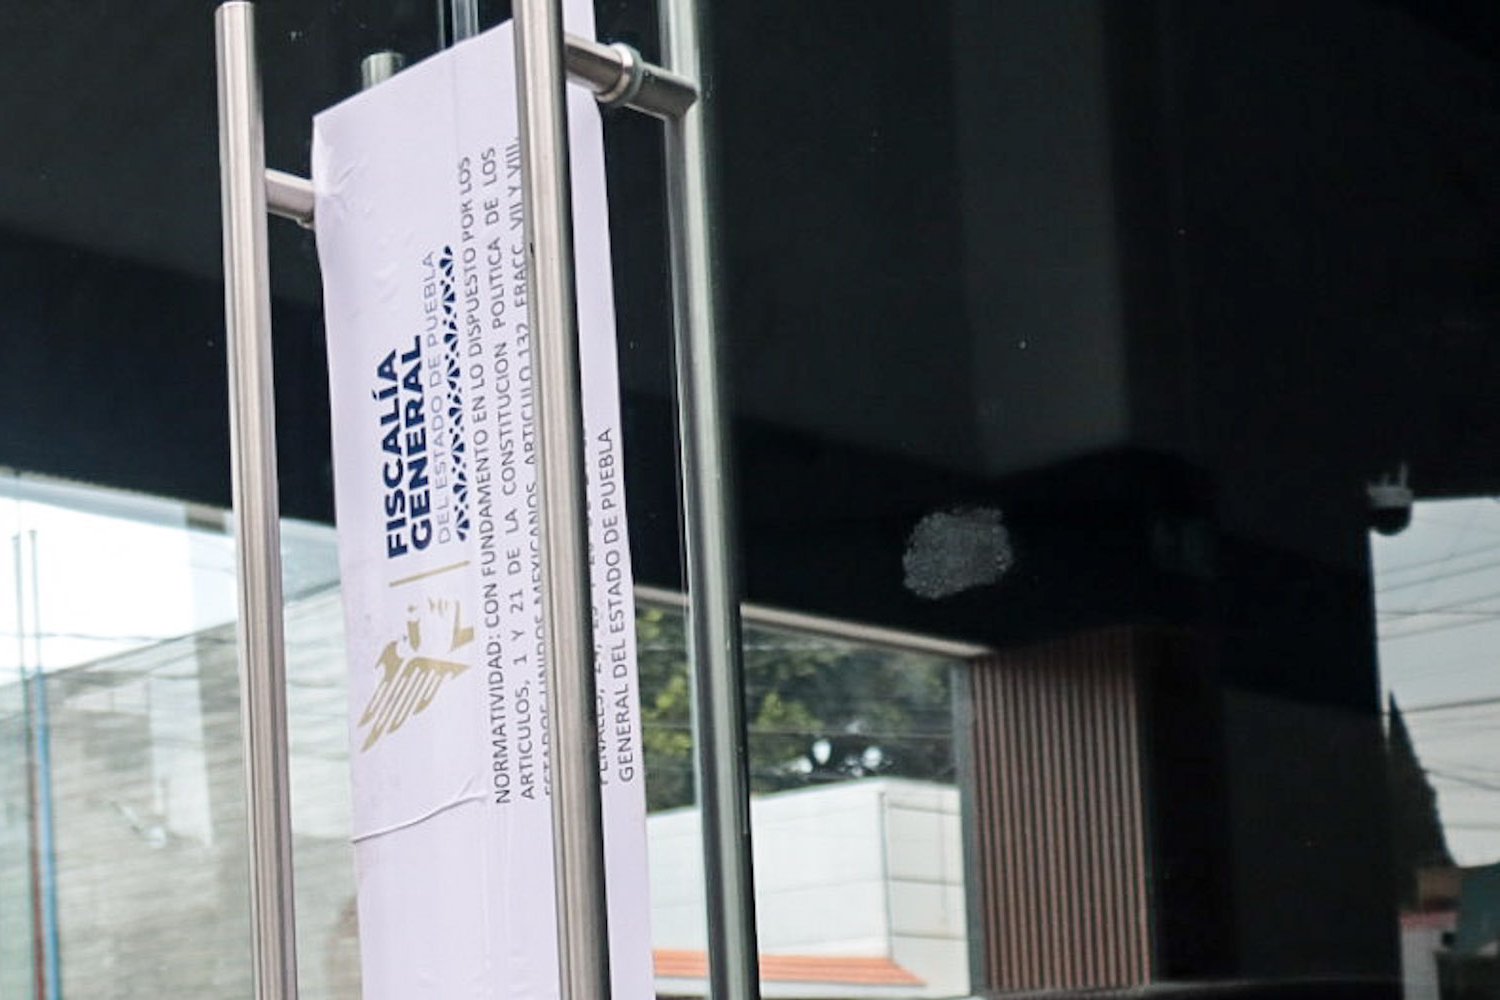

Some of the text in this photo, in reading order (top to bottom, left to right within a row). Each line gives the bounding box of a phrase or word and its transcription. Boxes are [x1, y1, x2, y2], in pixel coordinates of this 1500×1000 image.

[457, 156, 472, 194] LOS
[506, 184, 522, 196] Y
[462, 247, 482, 357] DISPUESTO
[402, 335, 432, 550] GENERAL
[422, 250, 452, 544] DEL ESTADO DE PUEBLA
[468, 364, 484, 390] LO
[470, 396, 487, 424] EN
[371, 349, 408, 559] FISCALÍA
[472, 429, 496, 577] FUNDAMENTO
[480, 147, 536, 800] ARTICULOS, 1 Y 21 DE LA CONSTITUCION POLITICA DE LOS
[480, 582, 500, 628] CON
[597, 427, 634, 782] GENERAL DEL ESTADO DE PUEBLA
[486, 633, 511, 804] NORMATIVIDAD:
